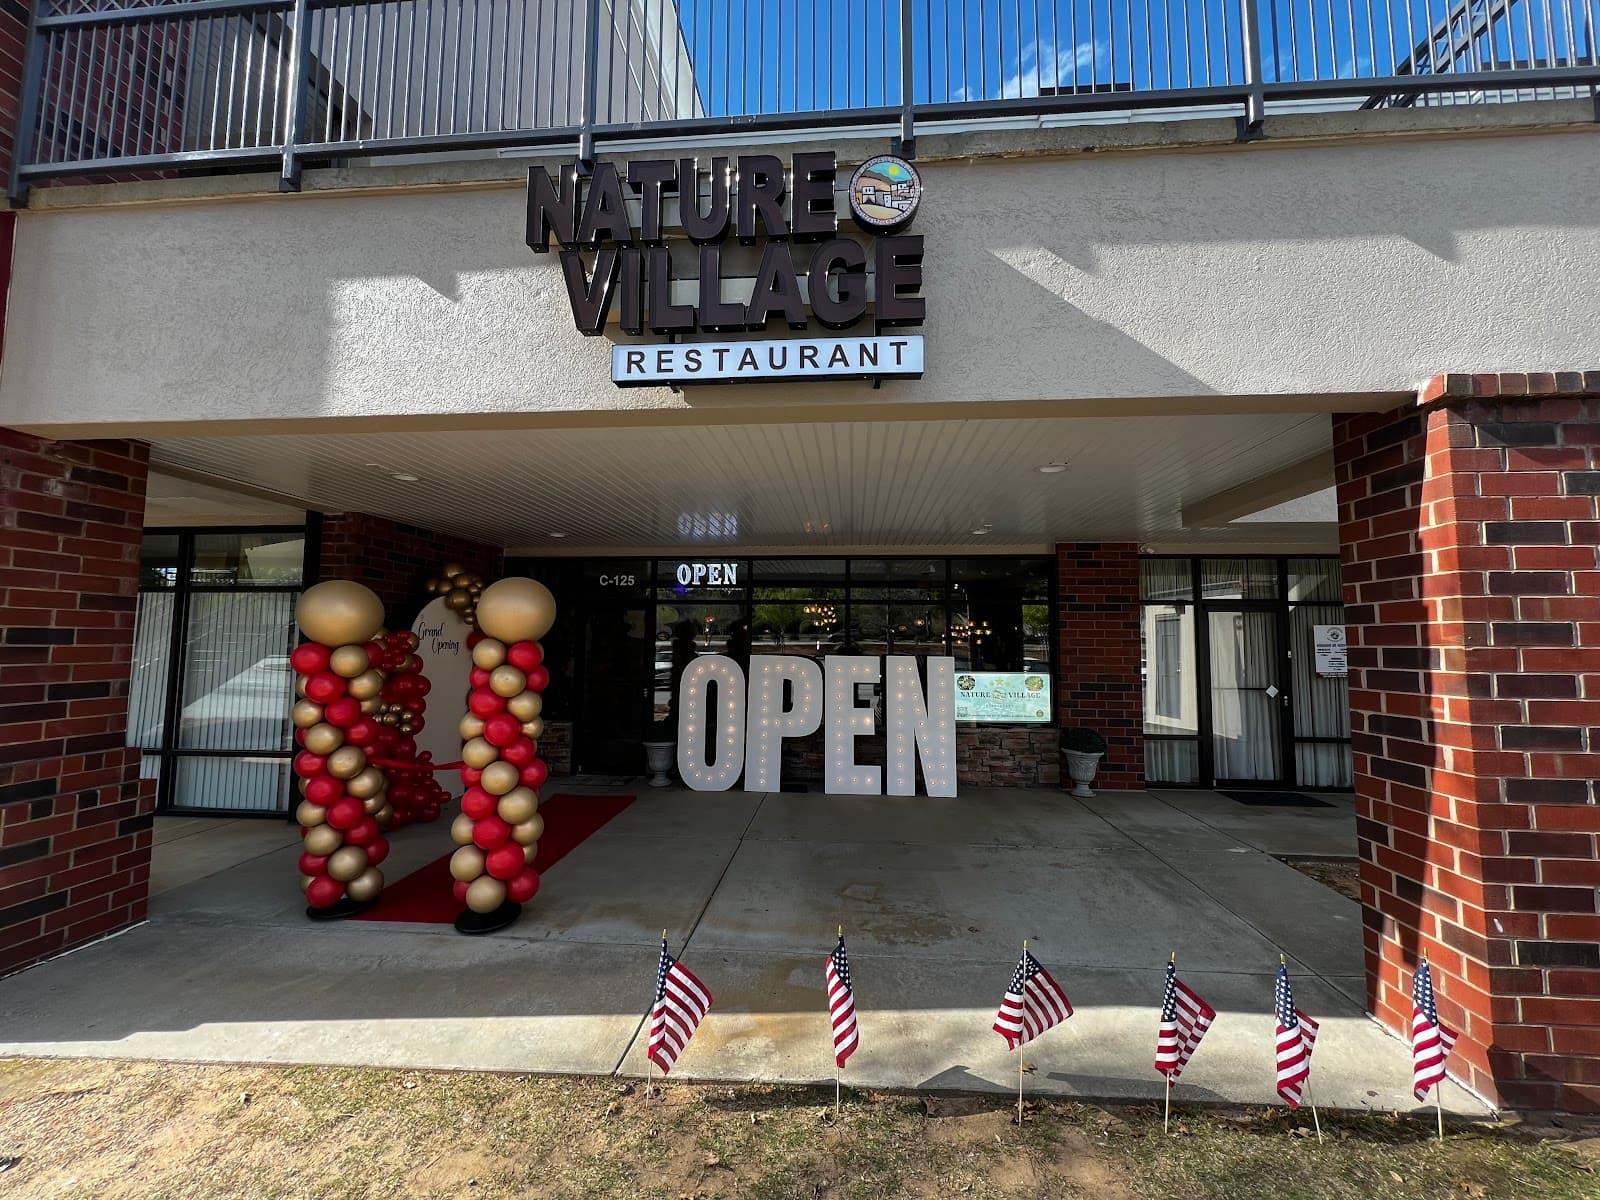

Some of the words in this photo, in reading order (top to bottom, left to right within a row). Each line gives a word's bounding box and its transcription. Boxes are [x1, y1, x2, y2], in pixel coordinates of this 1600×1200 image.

[526, 151, 837, 250] NATURE
[559, 235, 926, 336] VILLAGE
[626, 341, 909, 375] RESTAURANT
[599, 575, 635, 586] C-125
[676, 563, 738, 585] OPEN
[418, 621, 445, 640] Grand
[432, 637, 459, 656] Opening
[1008, 691, 1041, 699] VILLAGE
[677, 654, 957, 798] OPEN
